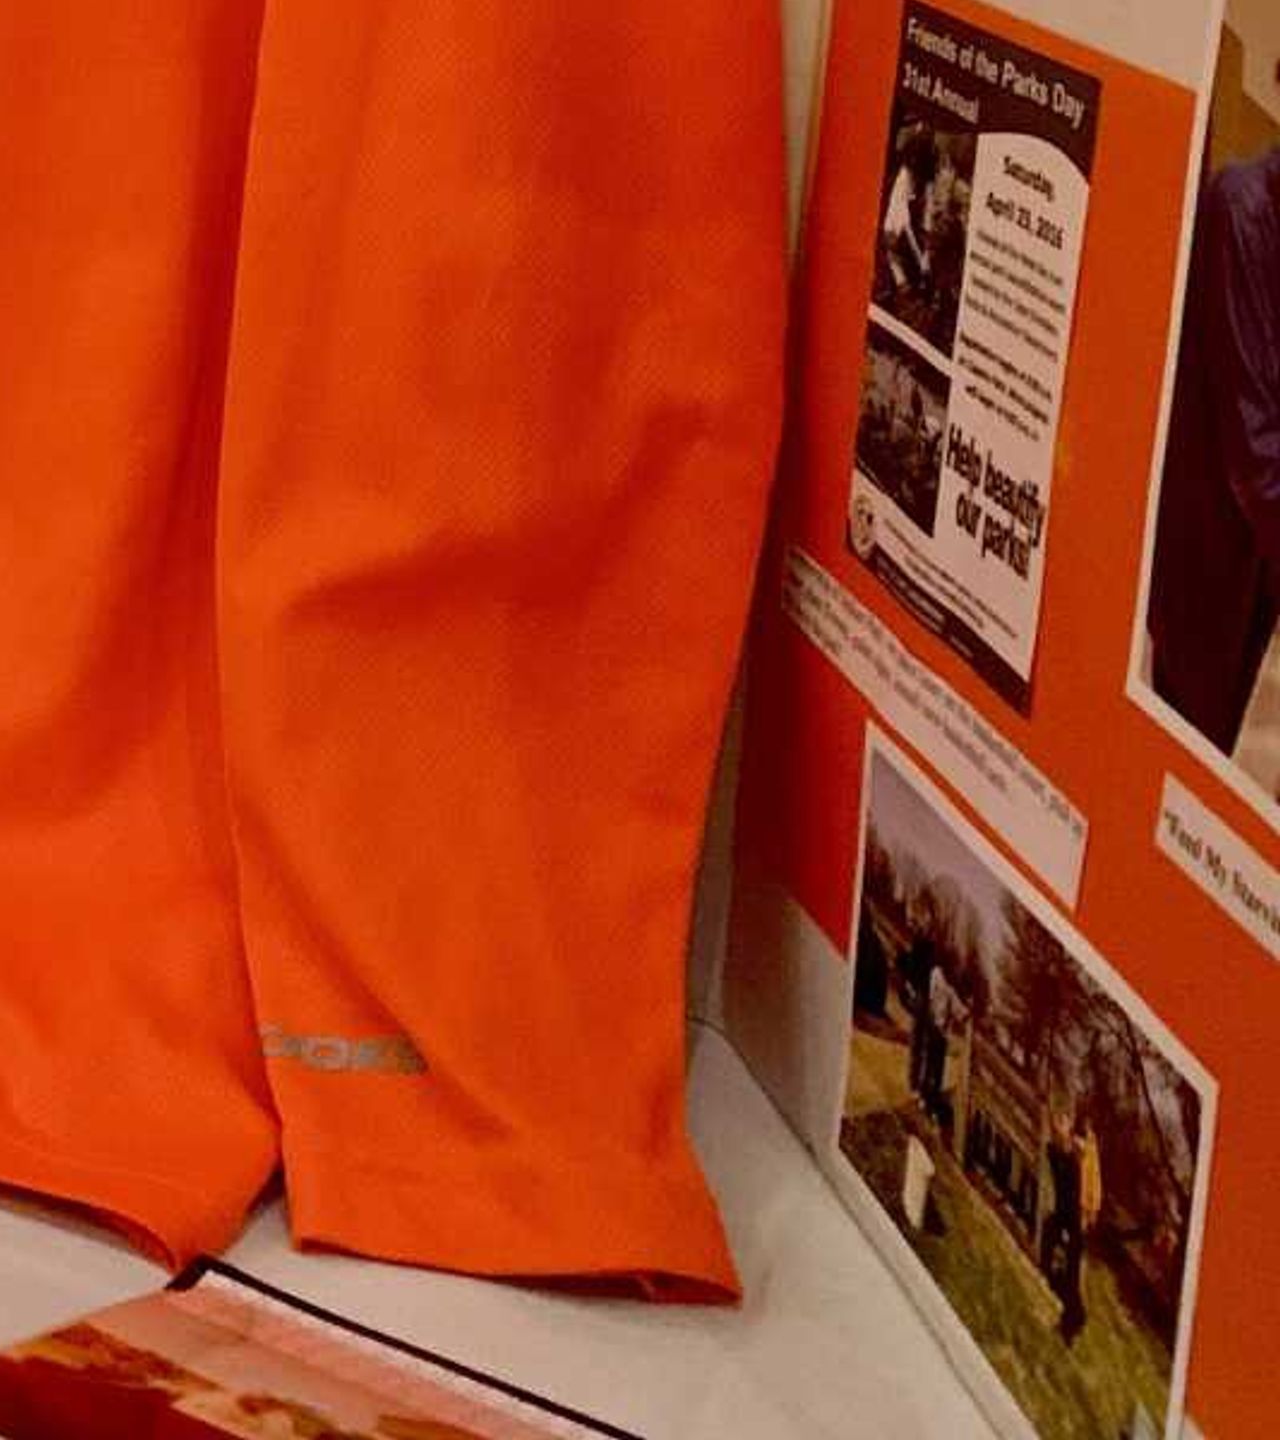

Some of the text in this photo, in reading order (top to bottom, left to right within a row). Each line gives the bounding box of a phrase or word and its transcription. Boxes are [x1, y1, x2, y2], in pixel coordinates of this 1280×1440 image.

[907, 17, 1086, 131] Friends of the Parks Day
[932, 76, 980, 125] Annual
[986, 191, 1015, 221] April
[946, 423, 1046, 548] Help beautify
[956, 492, 984, 540] our
[1206, 845, 1227, 889] My
